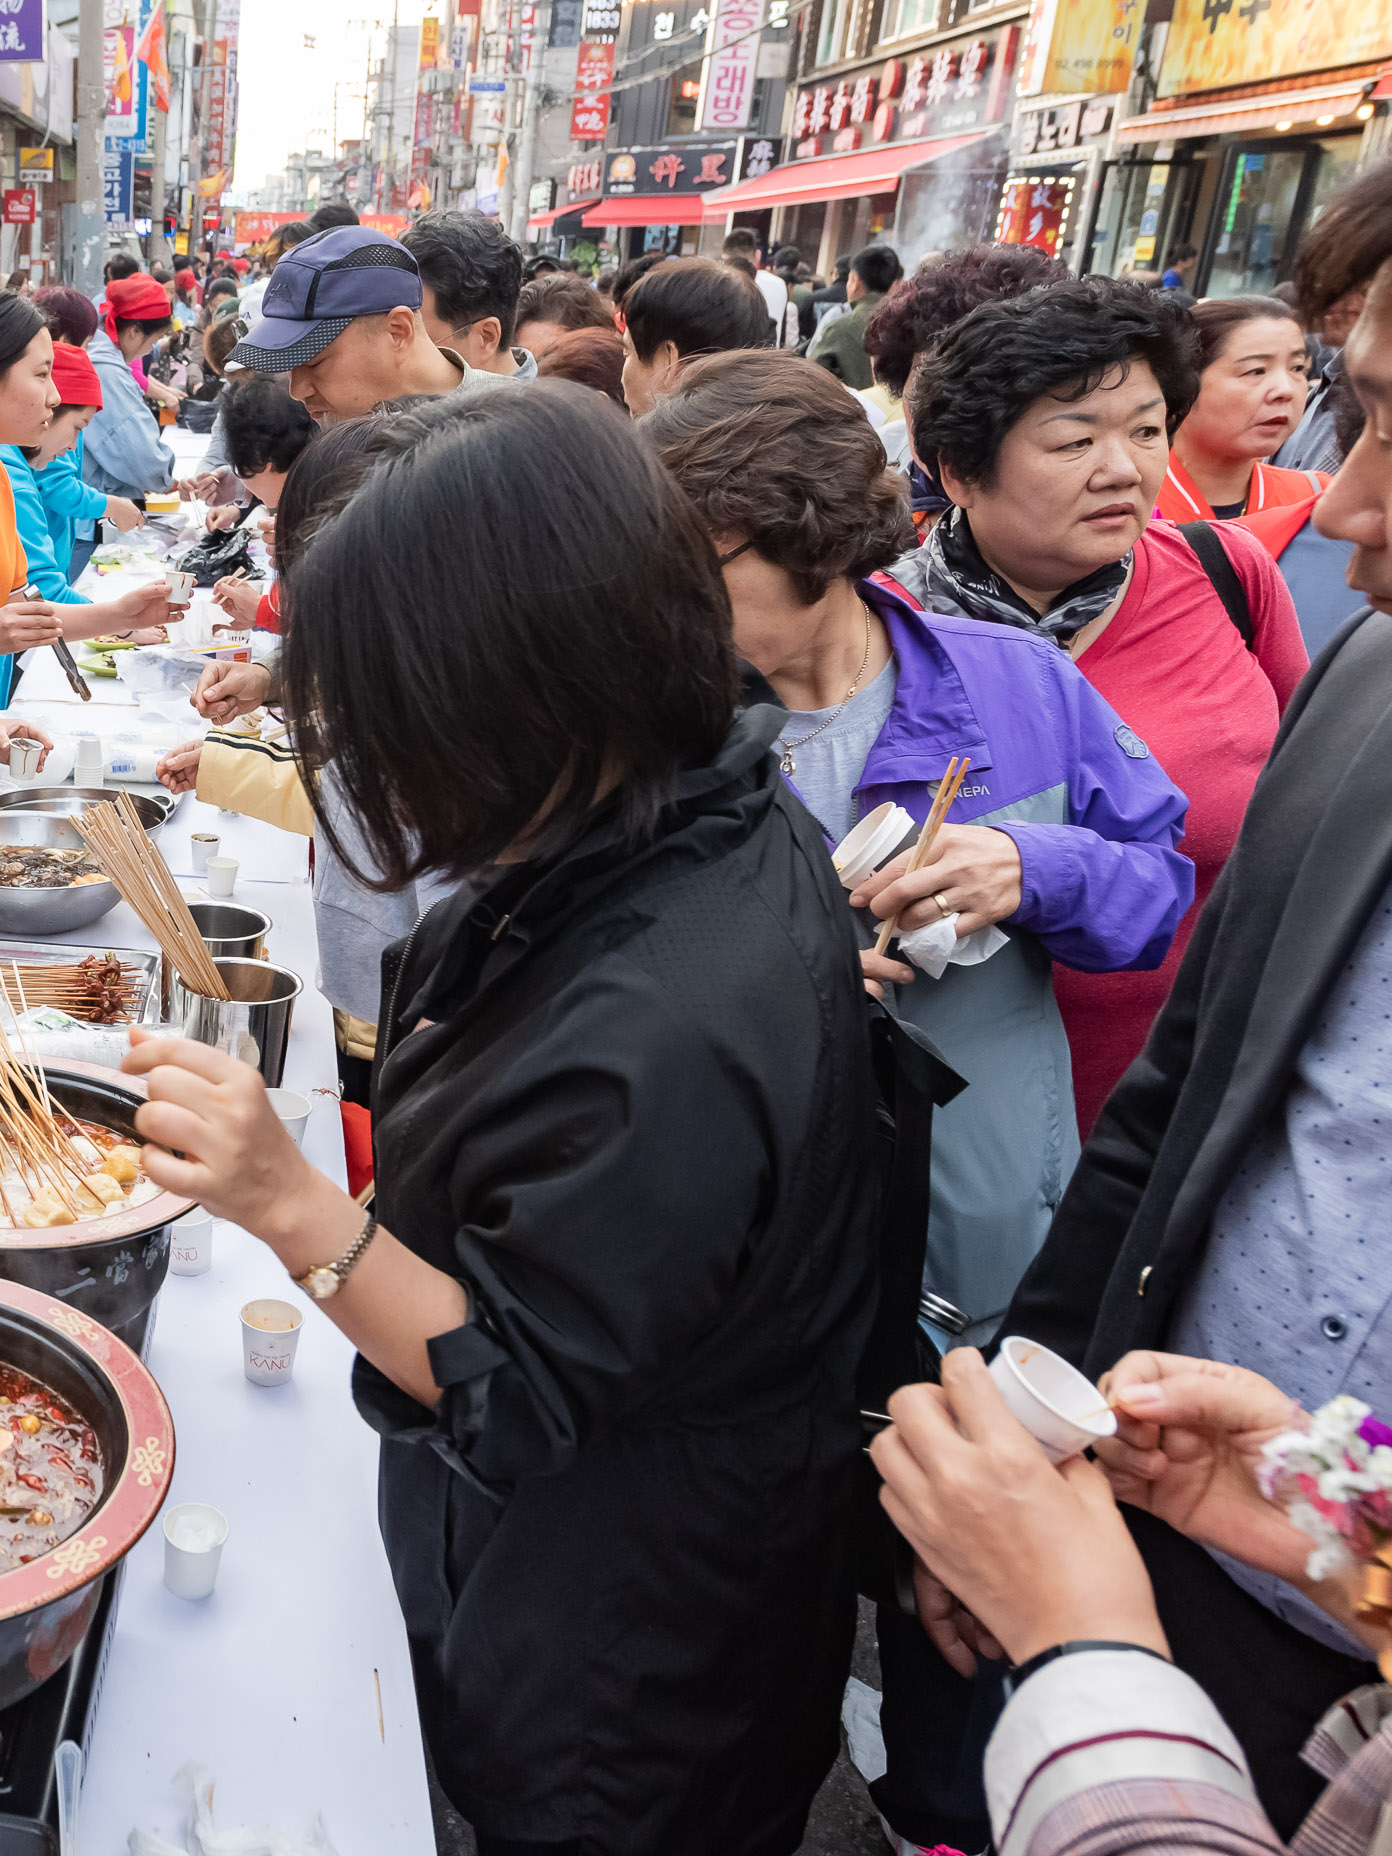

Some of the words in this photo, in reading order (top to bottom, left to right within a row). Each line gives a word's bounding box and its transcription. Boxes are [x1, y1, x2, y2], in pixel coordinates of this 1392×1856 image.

[955, 784, 991, 799] NEPA
[169, 1249, 198, 1262] ANU
[249, 1353, 291, 1371] KANU
